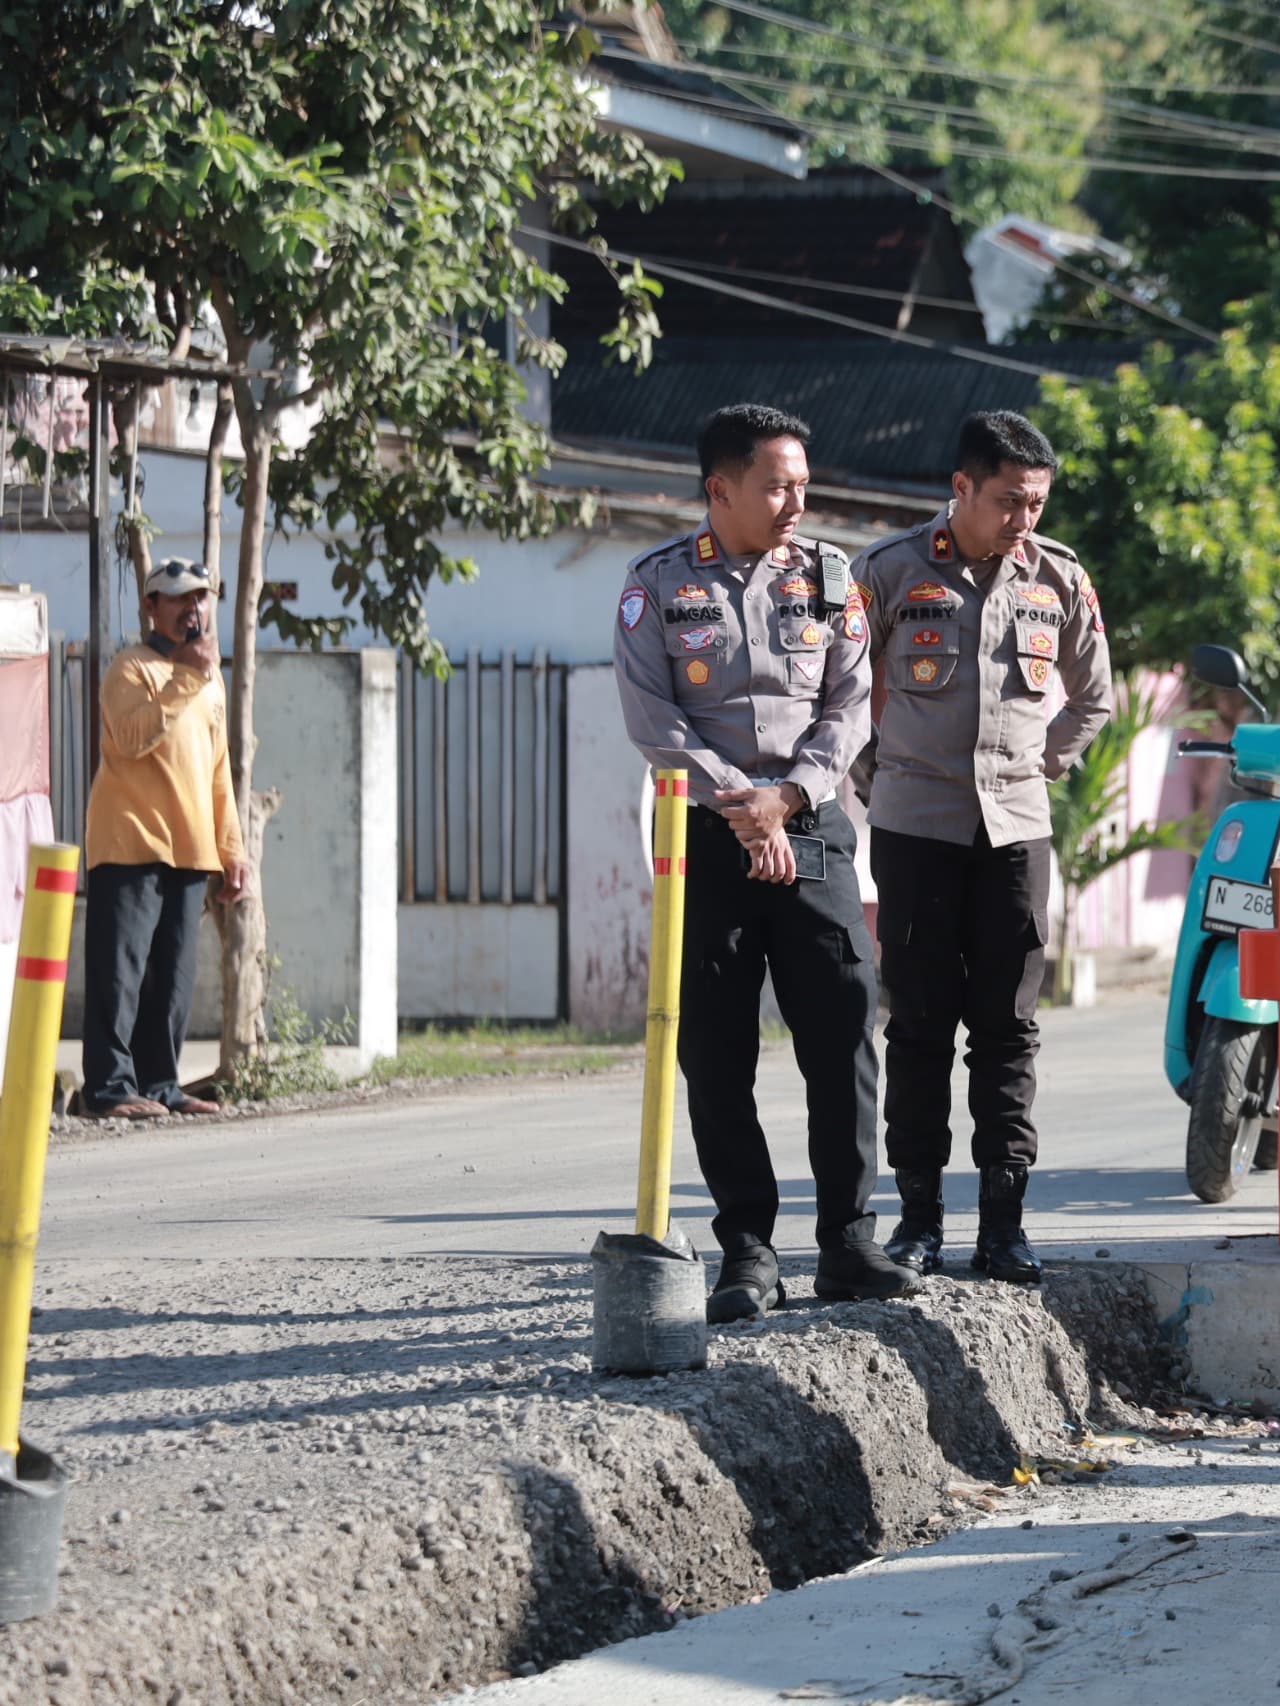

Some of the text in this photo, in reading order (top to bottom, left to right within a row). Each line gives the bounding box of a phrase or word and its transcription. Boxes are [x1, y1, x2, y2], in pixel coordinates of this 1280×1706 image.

[664, 606, 723, 624] BAGAS
[1215, 886, 1273, 916] N 268
